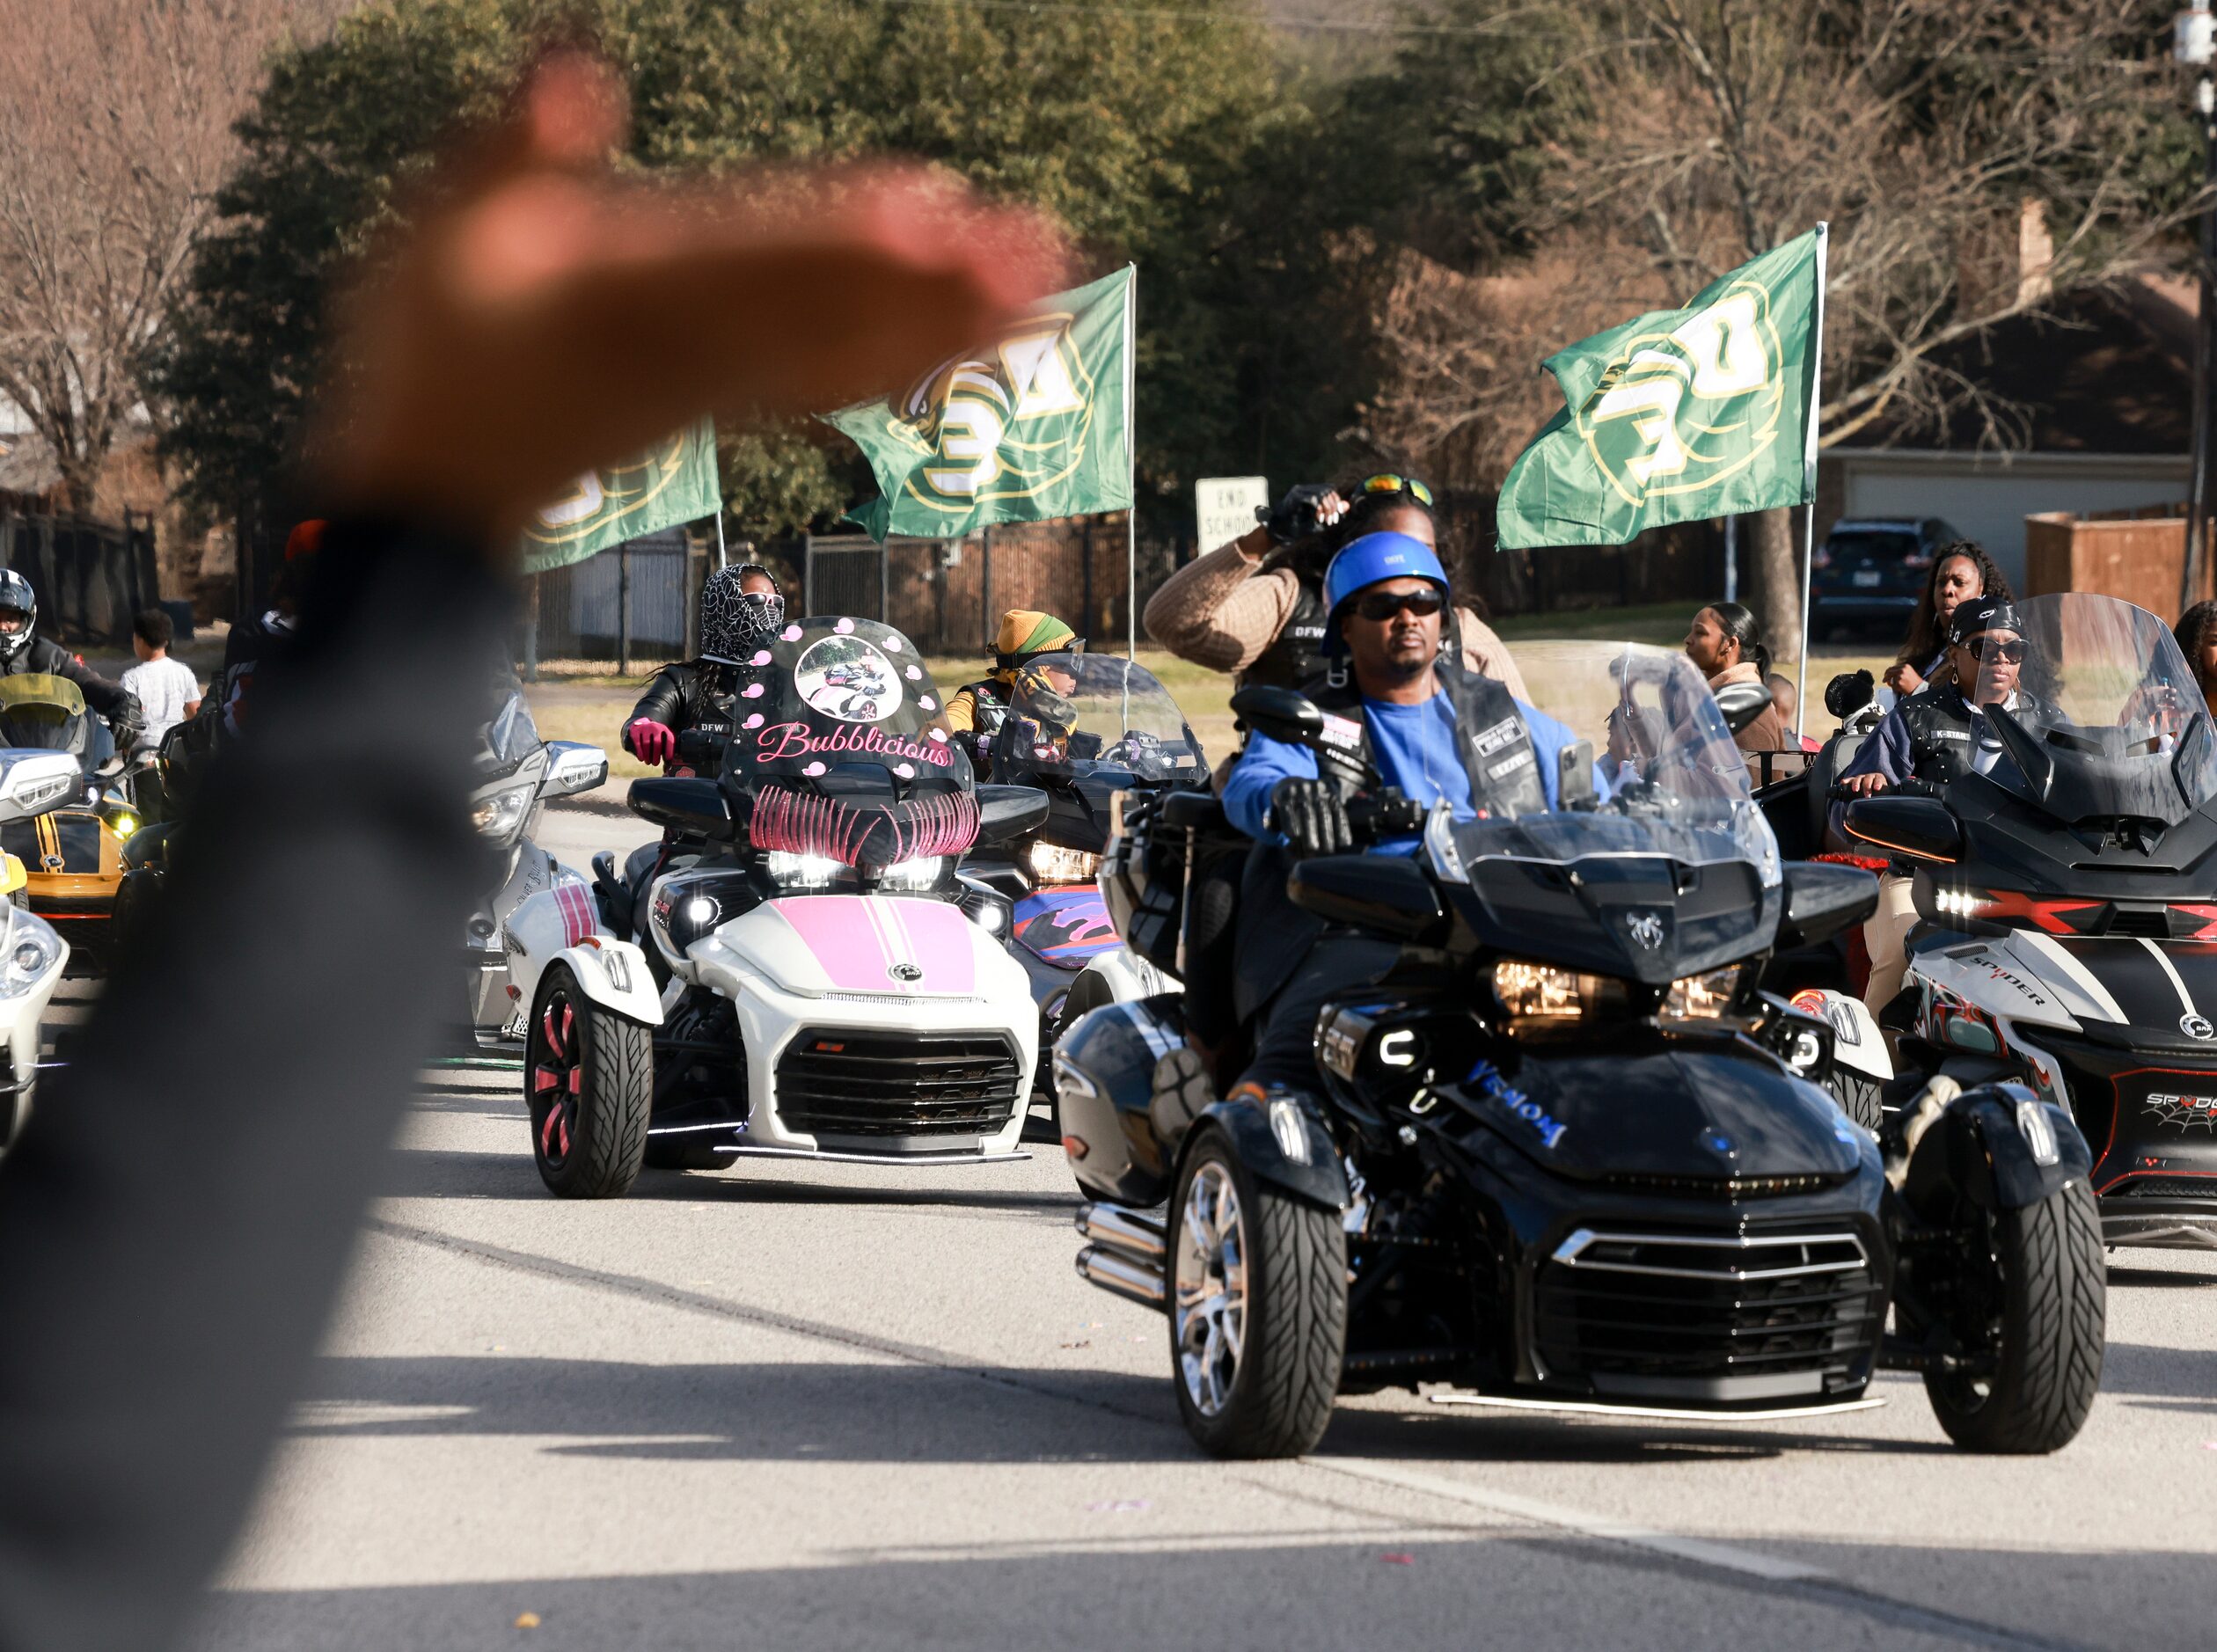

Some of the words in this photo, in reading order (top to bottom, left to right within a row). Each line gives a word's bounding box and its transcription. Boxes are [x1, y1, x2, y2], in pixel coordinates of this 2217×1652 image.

[1217, 488, 1247, 509] END
[1205, 515, 1256, 536] SCHOO
[1294, 625, 1327, 639] DFW
[701, 723, 724, 732] DFW
[1936, 730, 1966, 740] K-STAR
[757, 720, 949, 767] Bubblicious
[1970, 957, 2045, 1006] SPYDER
[1465, 1058, 1567, 1149] VENOM
